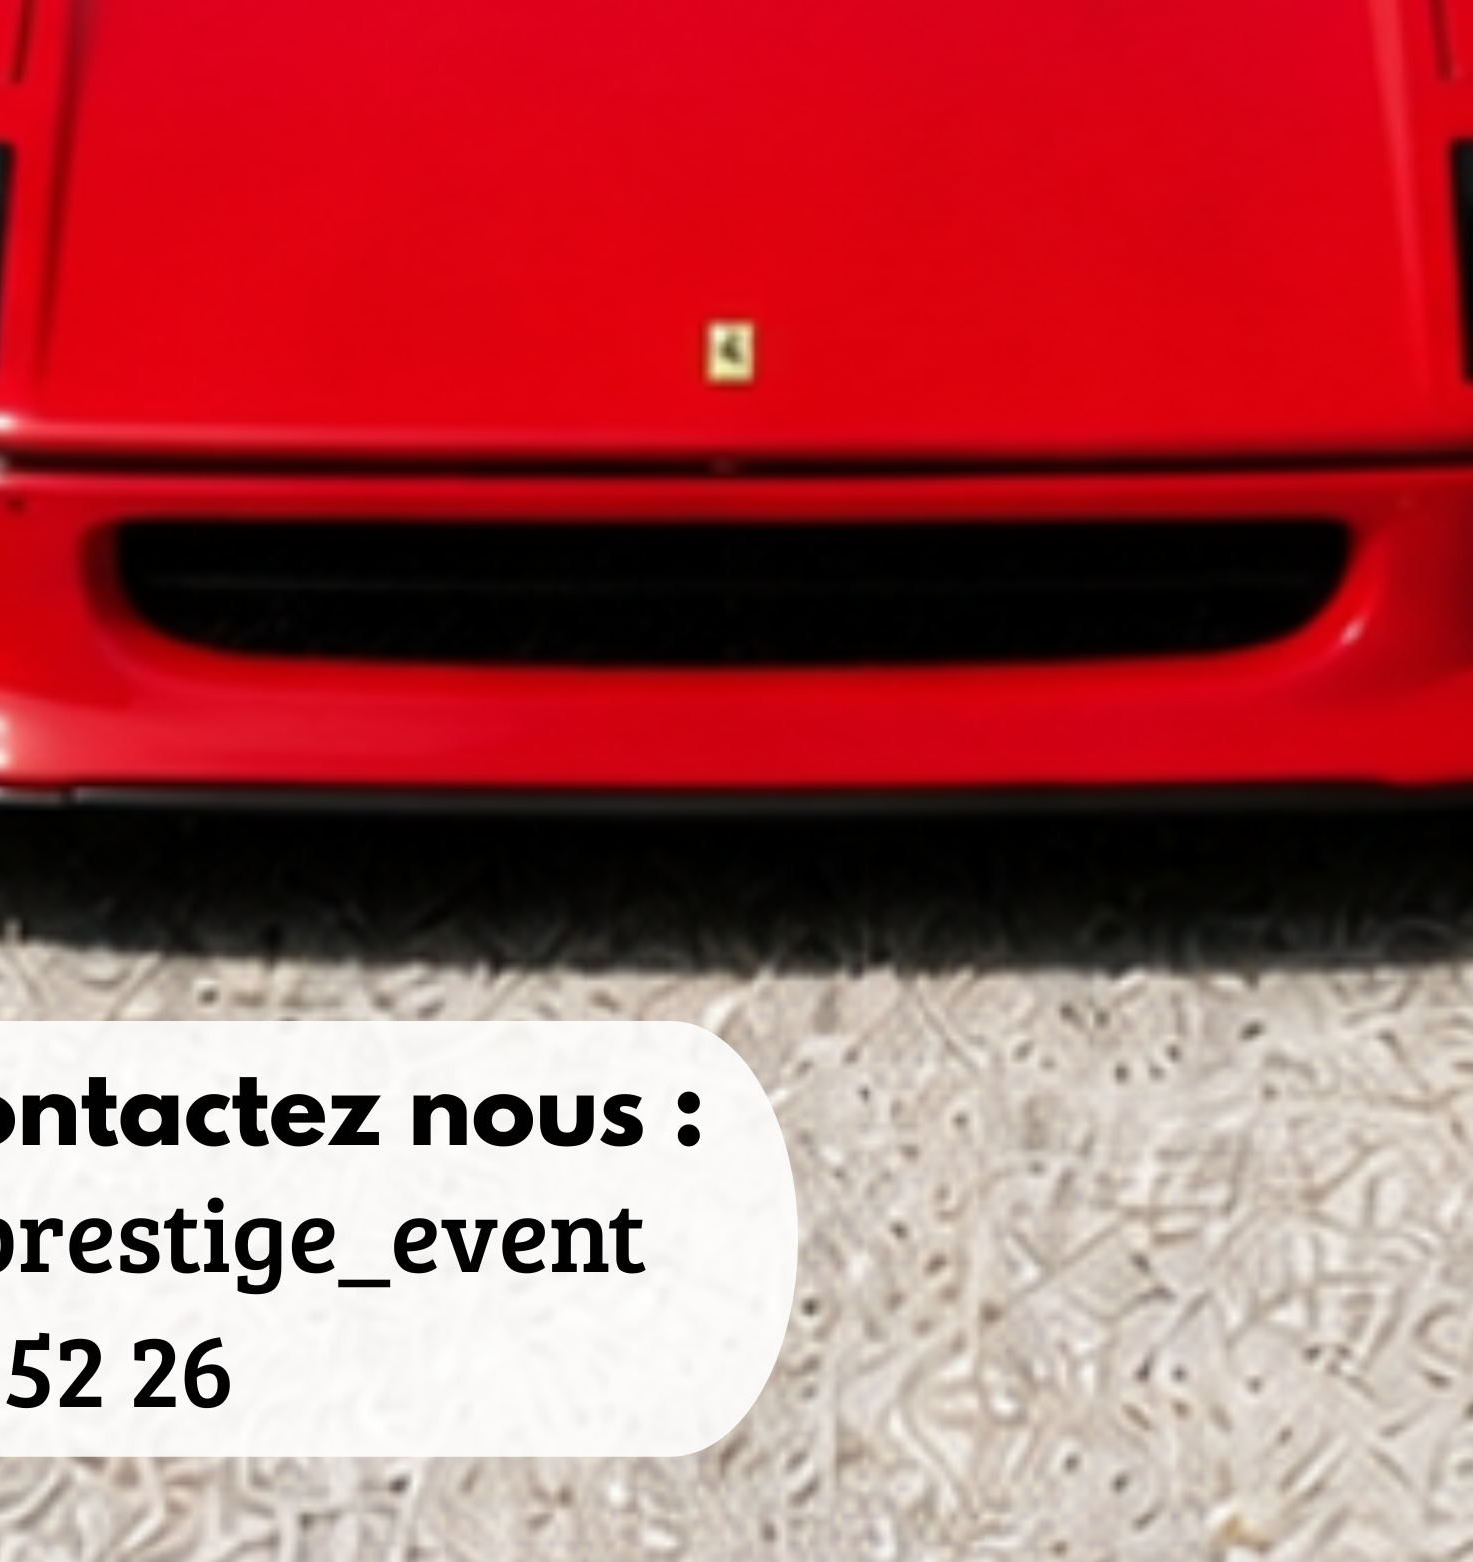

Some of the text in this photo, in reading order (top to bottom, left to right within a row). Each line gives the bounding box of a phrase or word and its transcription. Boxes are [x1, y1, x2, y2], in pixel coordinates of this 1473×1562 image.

[413, 1093, 644, 1147] nous
[677, 1091, 701, 1147] :
[6, 1332, 102, 1409] 52
[133, 1336, 231, 1409] 26
